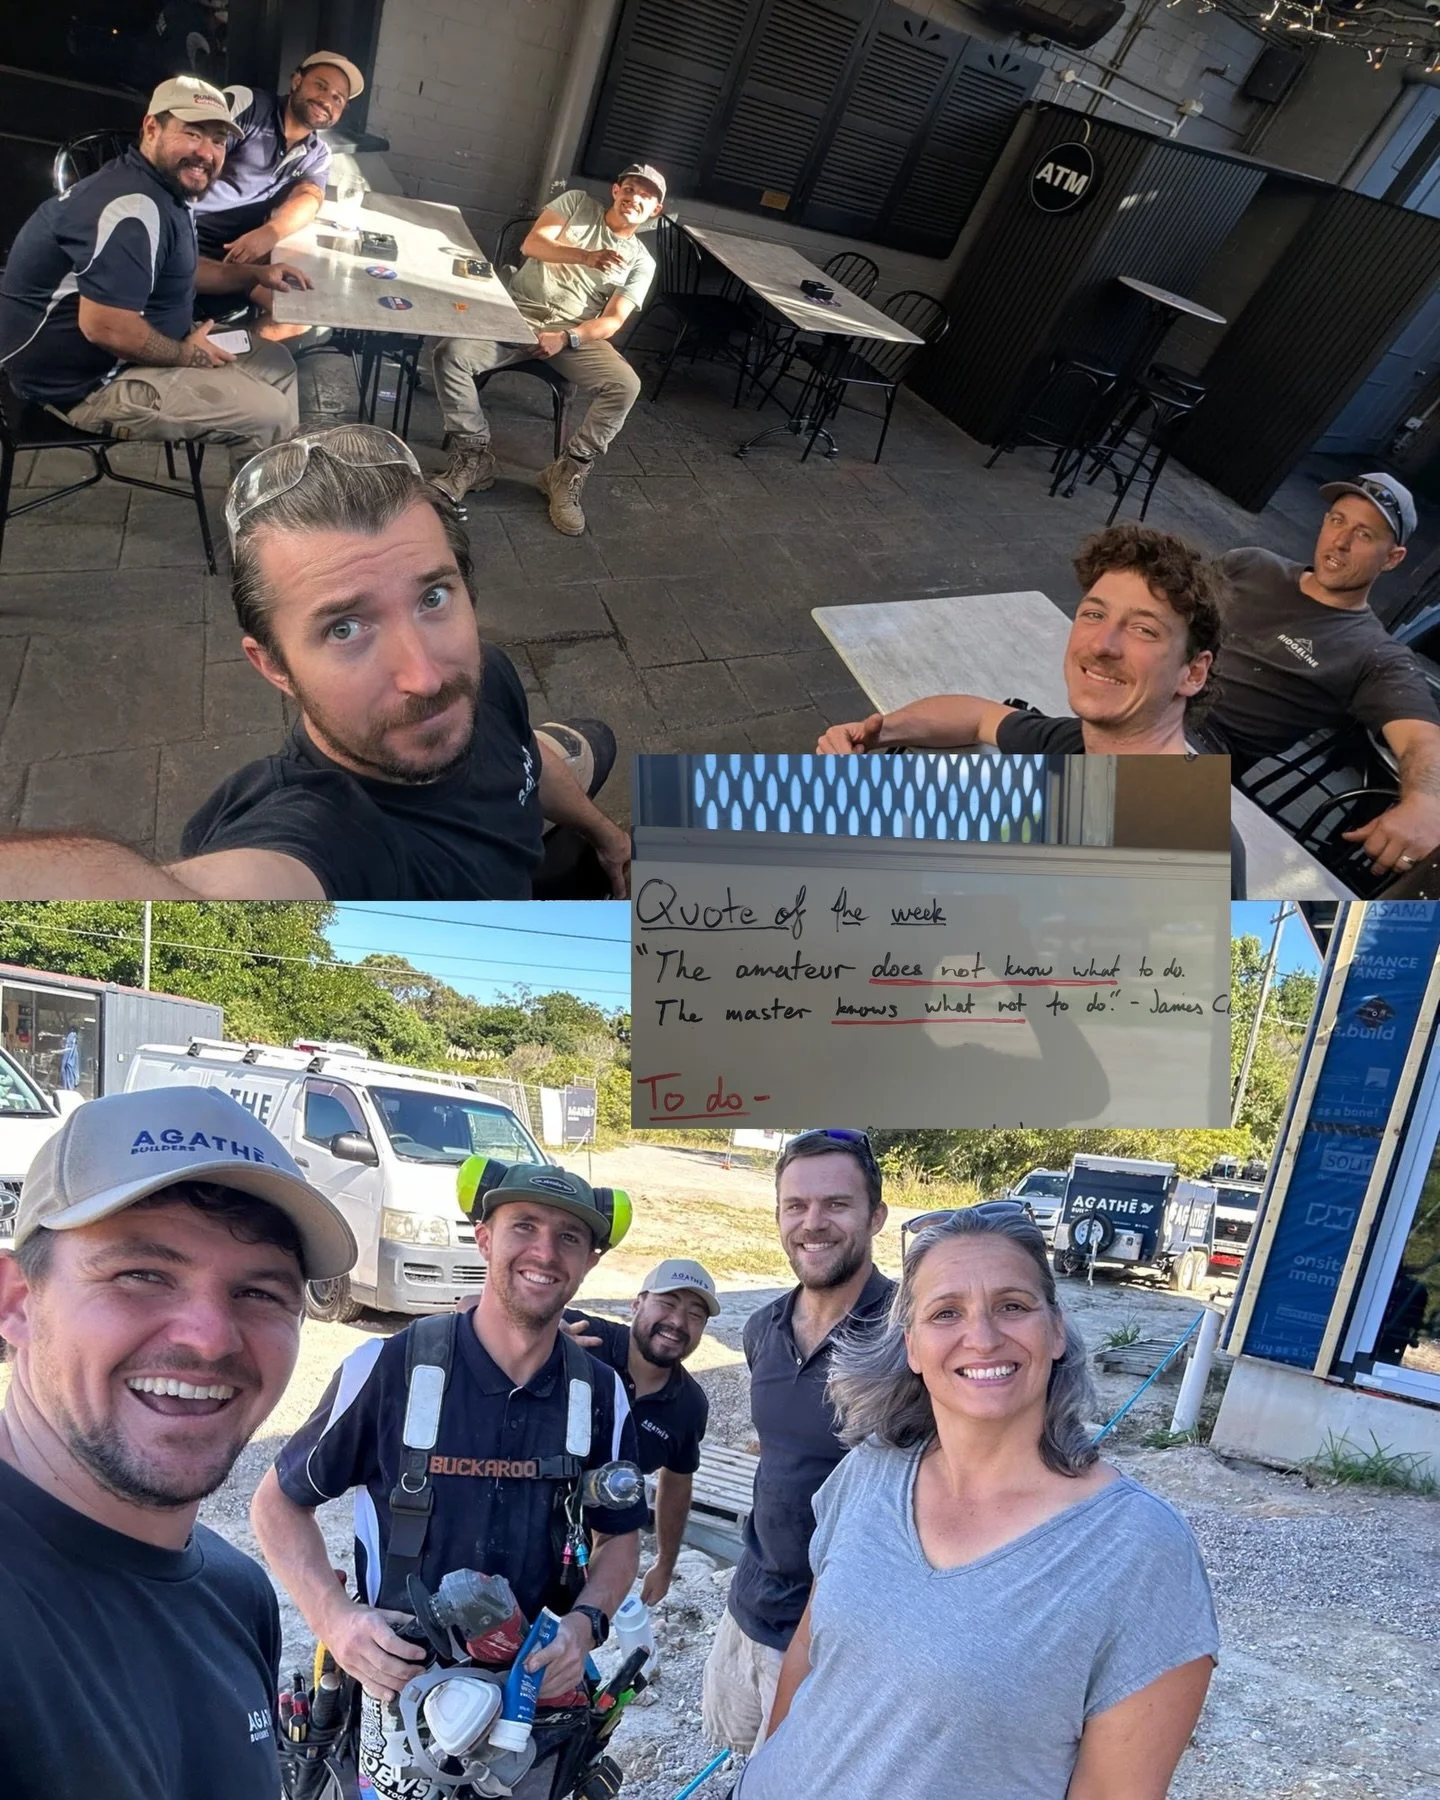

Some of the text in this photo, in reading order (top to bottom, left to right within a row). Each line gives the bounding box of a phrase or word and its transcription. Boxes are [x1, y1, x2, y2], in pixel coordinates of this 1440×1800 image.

[1036, 162, 1089, 195] ATM
[637, 879, 947, 940] Quote of the week
[736, 951, 856, 980] amateur
[872, 952, 923, 977] does
[941, 952, 985, 978] not
[1004, 955, 1053, 977] know
[1073, 955, 1120, 978] what
[1139, 956, 1154, 977] to
[1163, 957, 1186, 978] do.
[655, 998, 703, 1026] The
[725, 997, 812, 1022] master
[836, 996, 898, 1018] knows
[924, 993, 976, 1014] what
[998, 993, 1026, 1013] not
[1046, 991, 1070, 1016] to
[1150, 988, 1203, 1014] James
[637, 1072, 686, 1112] To
[131, 1144, 196, 1155] BUILDERS
[429, 1455, 537, 1478] BUCKAROO
